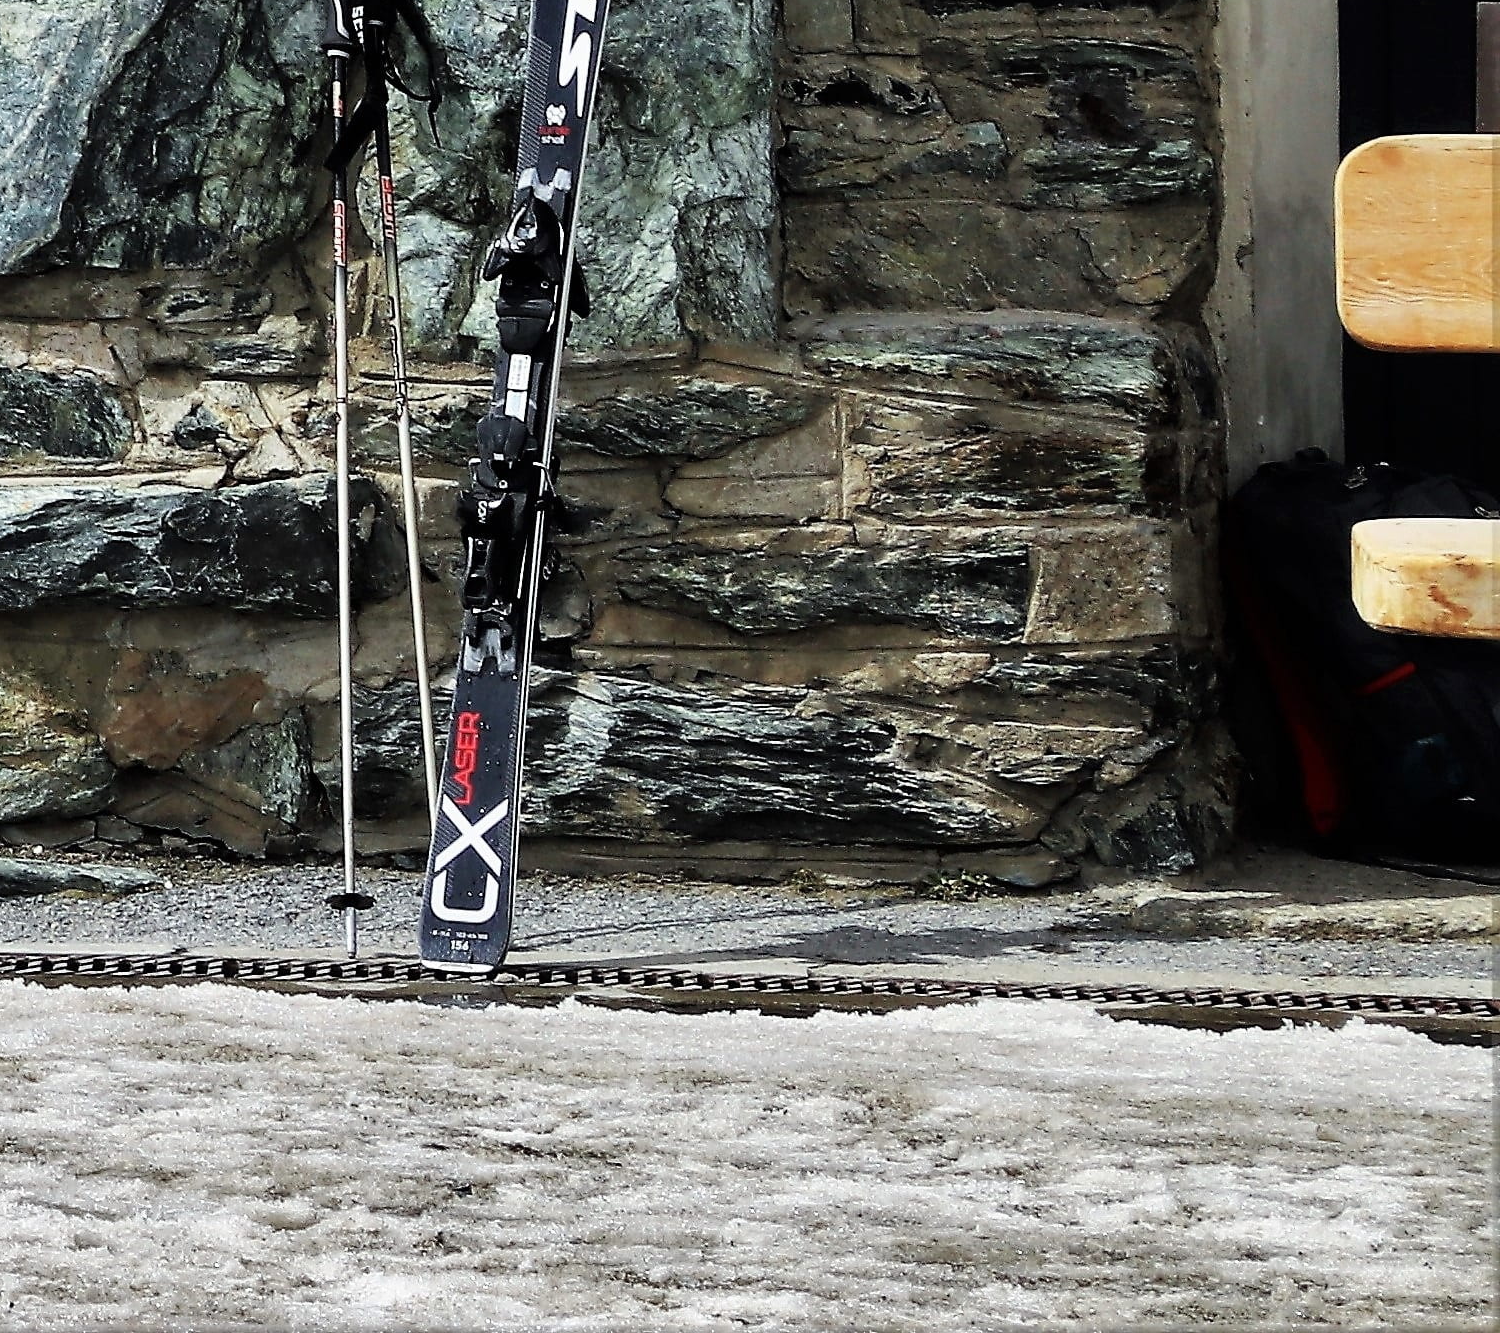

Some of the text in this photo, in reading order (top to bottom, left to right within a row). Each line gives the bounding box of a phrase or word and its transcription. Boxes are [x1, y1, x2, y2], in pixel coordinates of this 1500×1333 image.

[454, 711, 481, 805] LASER
[430, 793, 509, 923] CX
[450, 940, 469, 951] 156
